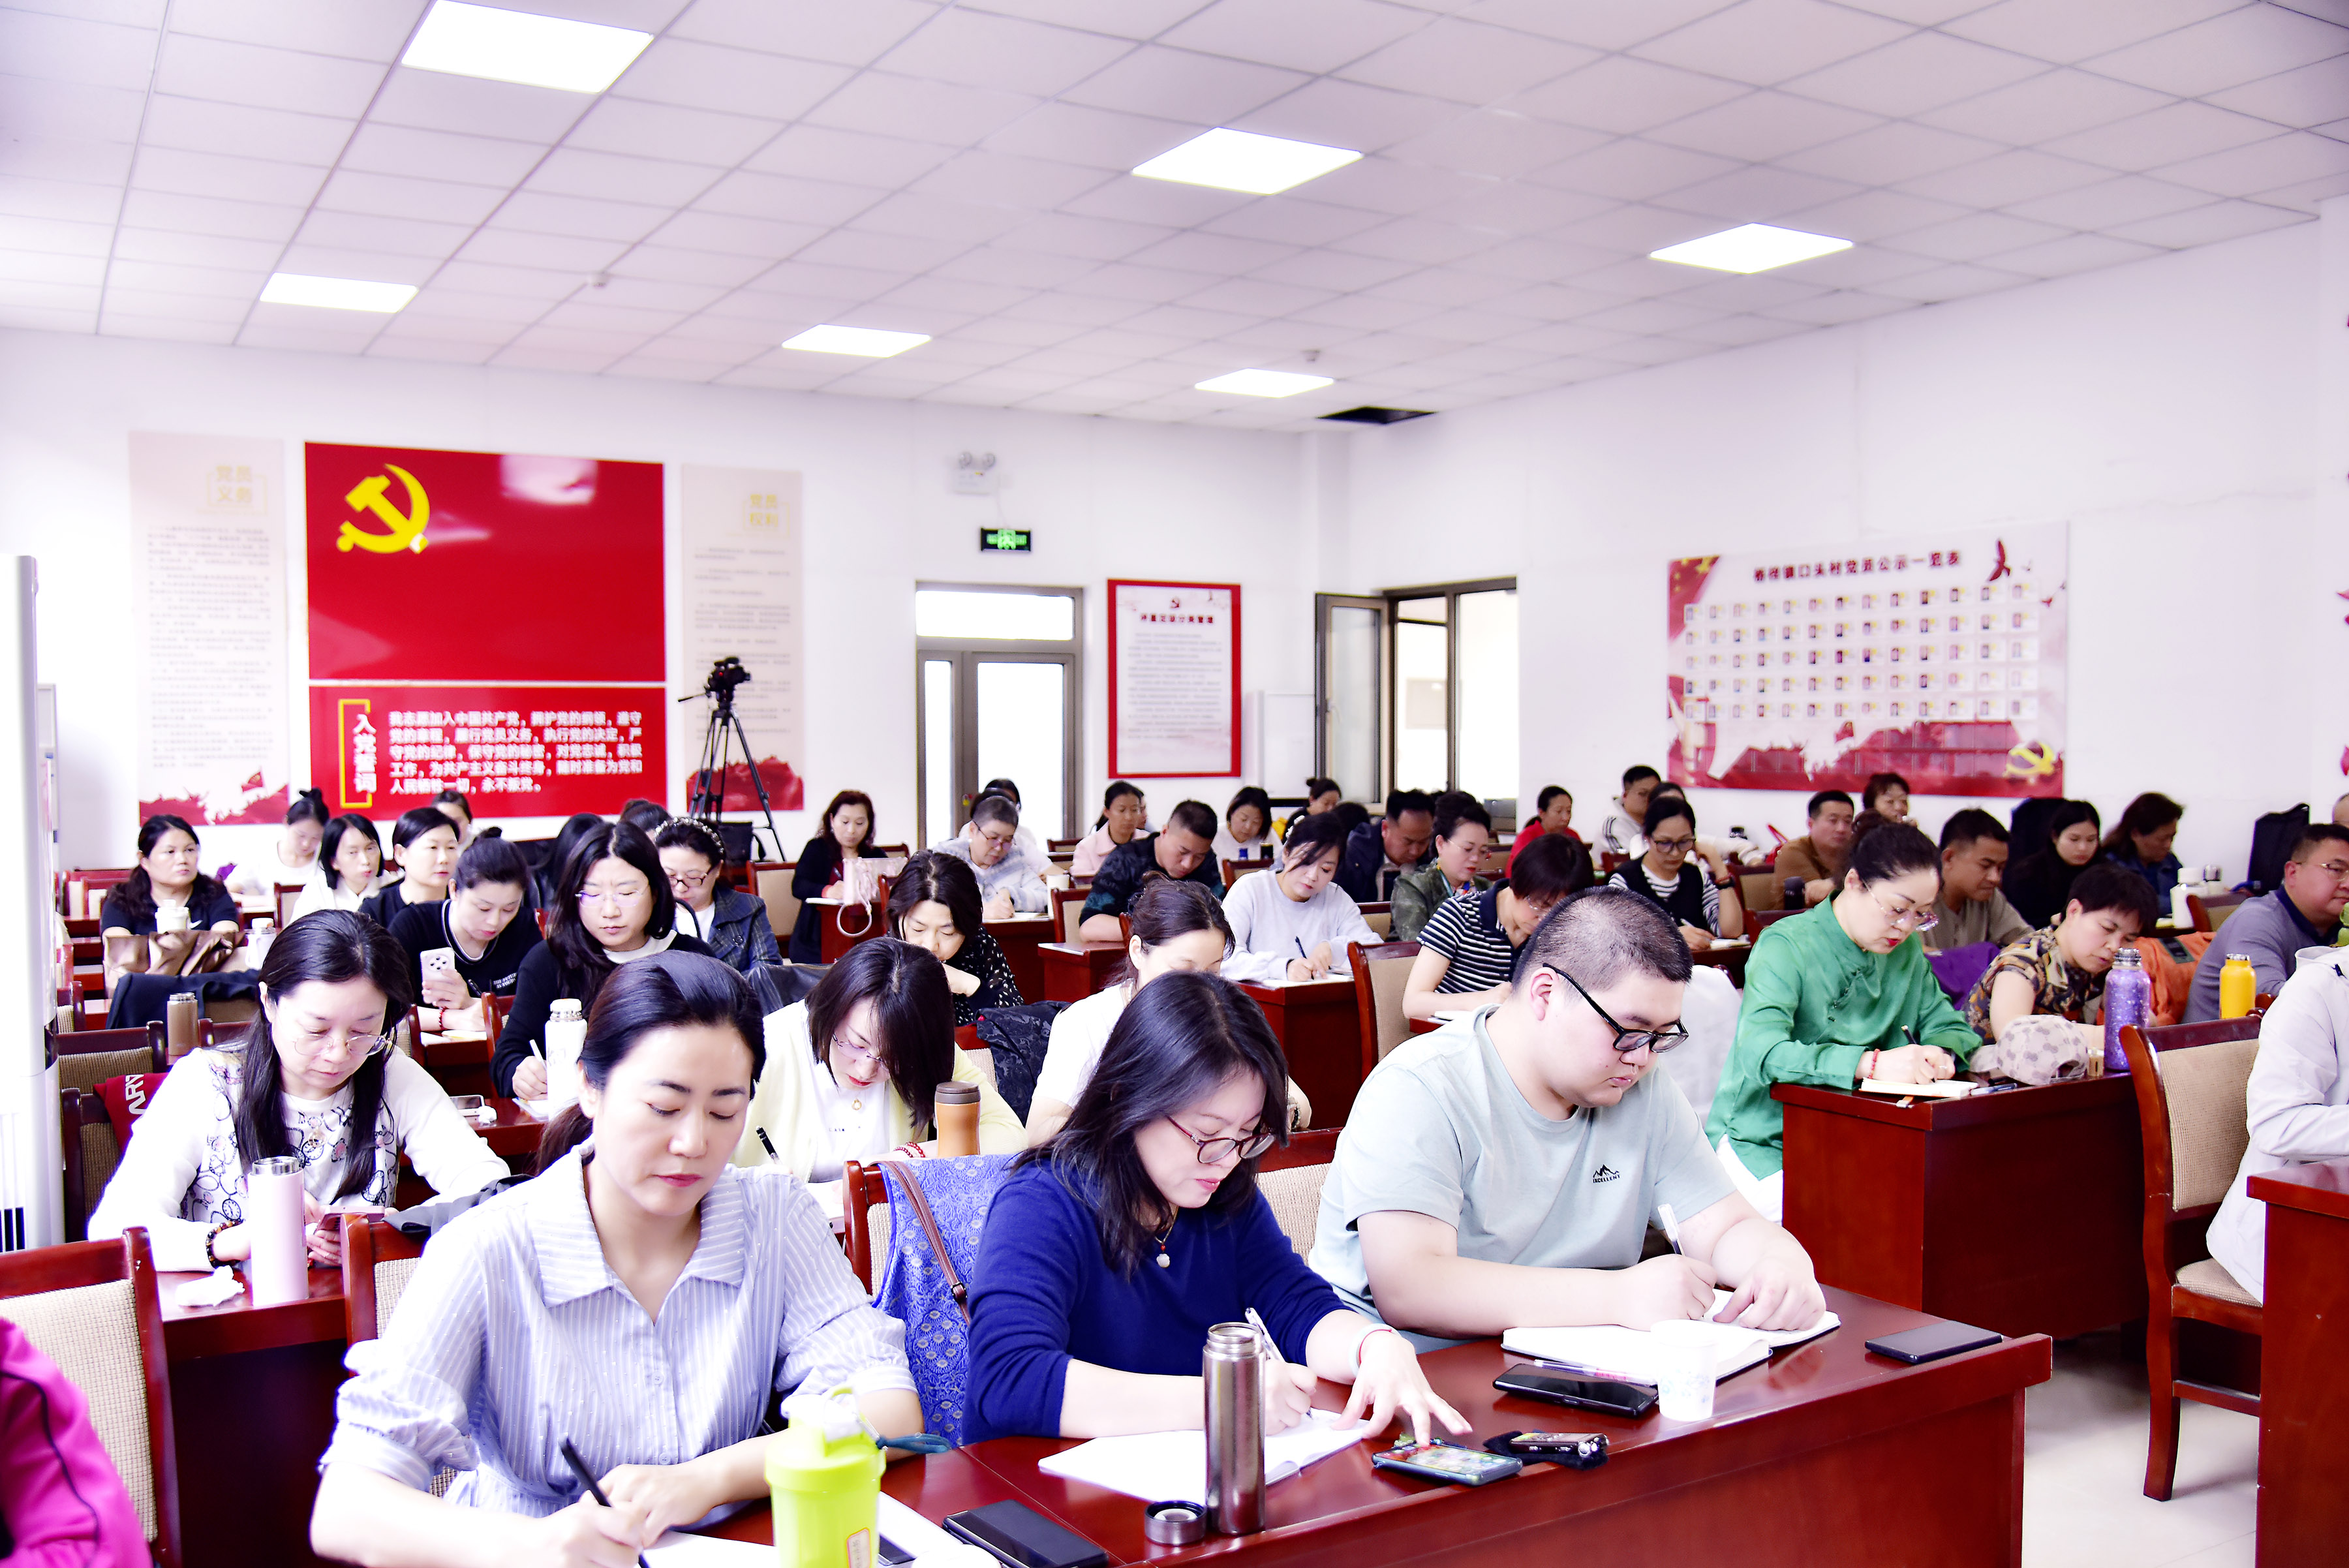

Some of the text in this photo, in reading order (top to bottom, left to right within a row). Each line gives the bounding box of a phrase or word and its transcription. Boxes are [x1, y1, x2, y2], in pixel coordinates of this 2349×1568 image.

[352, 713, 377, 794] 入党誓词
[1593, 1175, 1620, 1183] EXCELLENT
